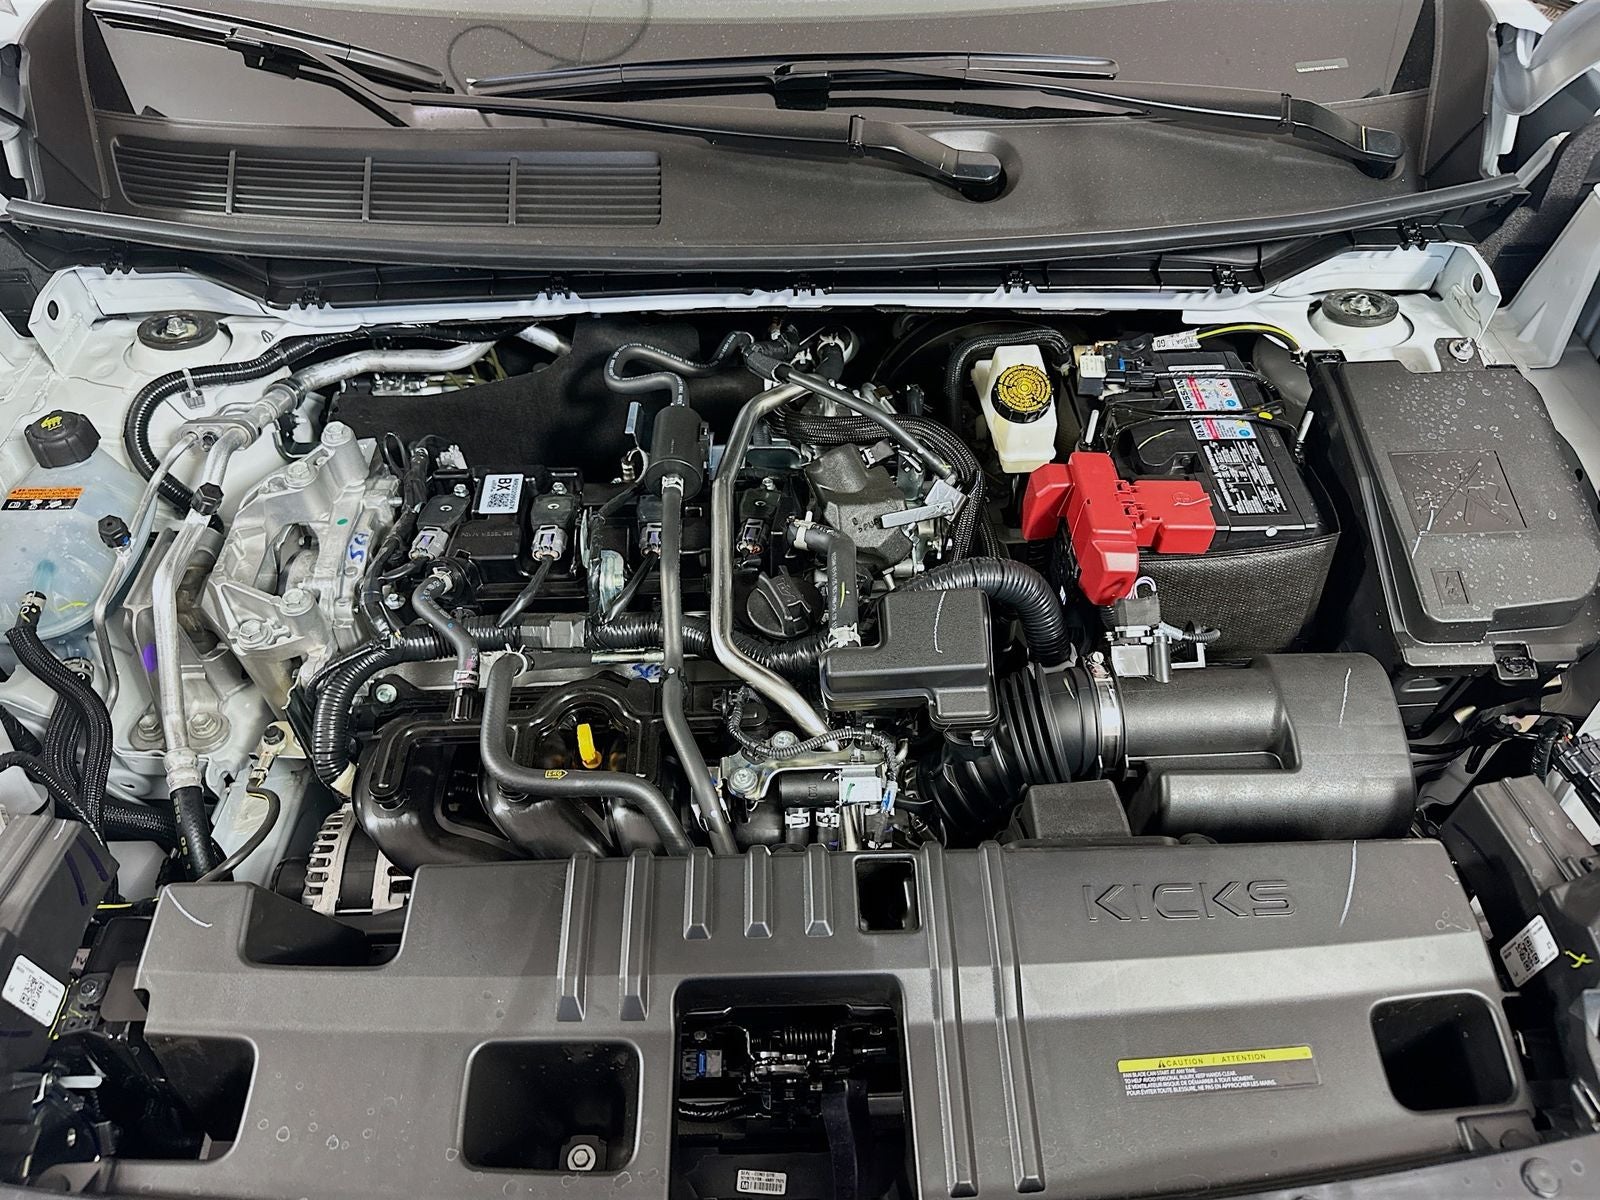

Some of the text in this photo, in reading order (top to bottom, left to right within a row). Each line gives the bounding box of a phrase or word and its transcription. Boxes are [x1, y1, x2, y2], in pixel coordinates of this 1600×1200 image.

[1175, 379, 1194, 409] NISSAN
[497, 478, 512, 491] BX
[1082, 879, 1296, 922] KICKS
[1166, 1058, 1204, 1067] CAUTION
[1222, 1054, 1266, 1063] ATTENTION
